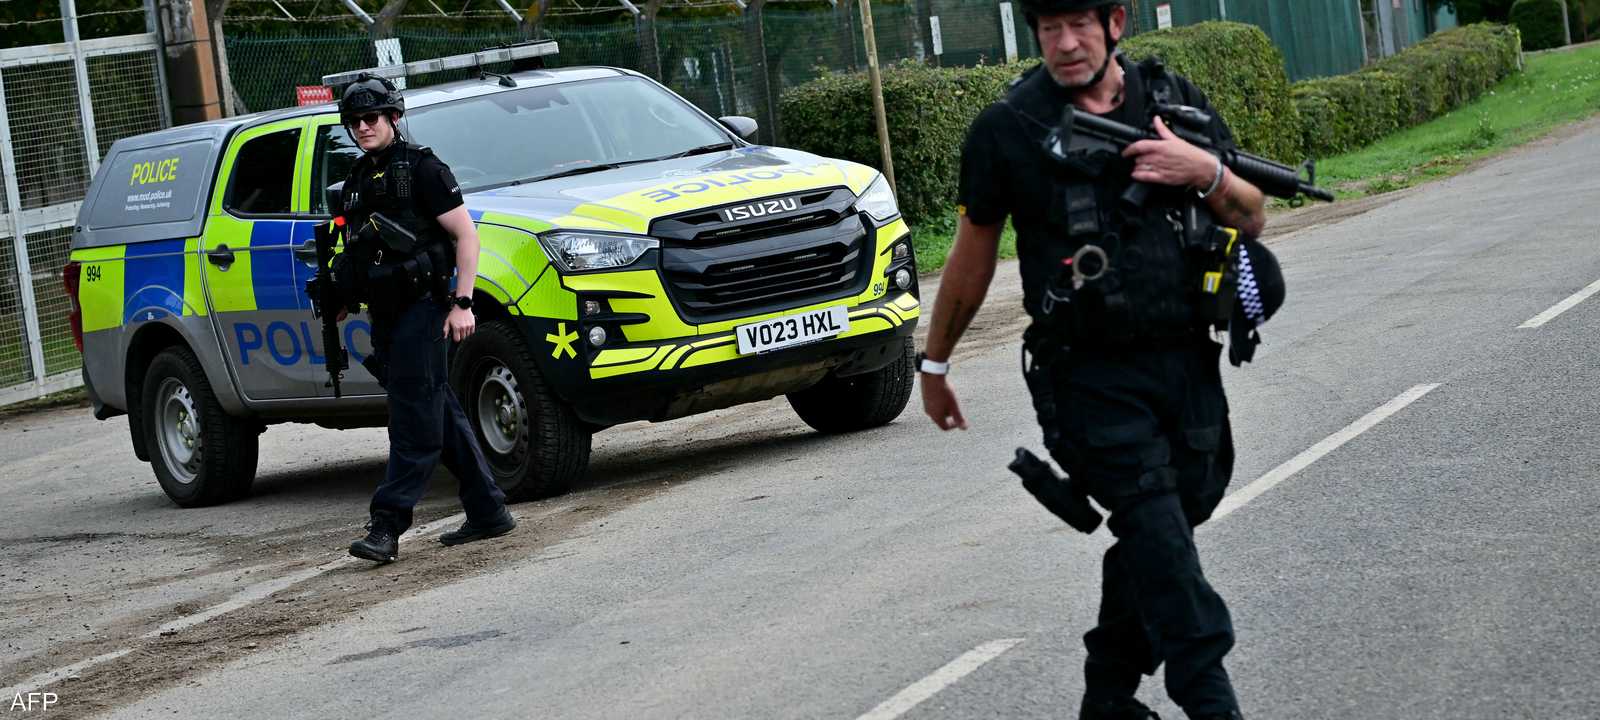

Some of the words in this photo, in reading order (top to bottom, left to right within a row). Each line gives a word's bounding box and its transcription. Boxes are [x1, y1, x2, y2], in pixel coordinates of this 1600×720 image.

[130, 158, 180, 186] POLICE
[724, 197, 798, 222] ISUZU
[86, 265, 101, 282] 994
[802, 310, 841, 337] HXL
